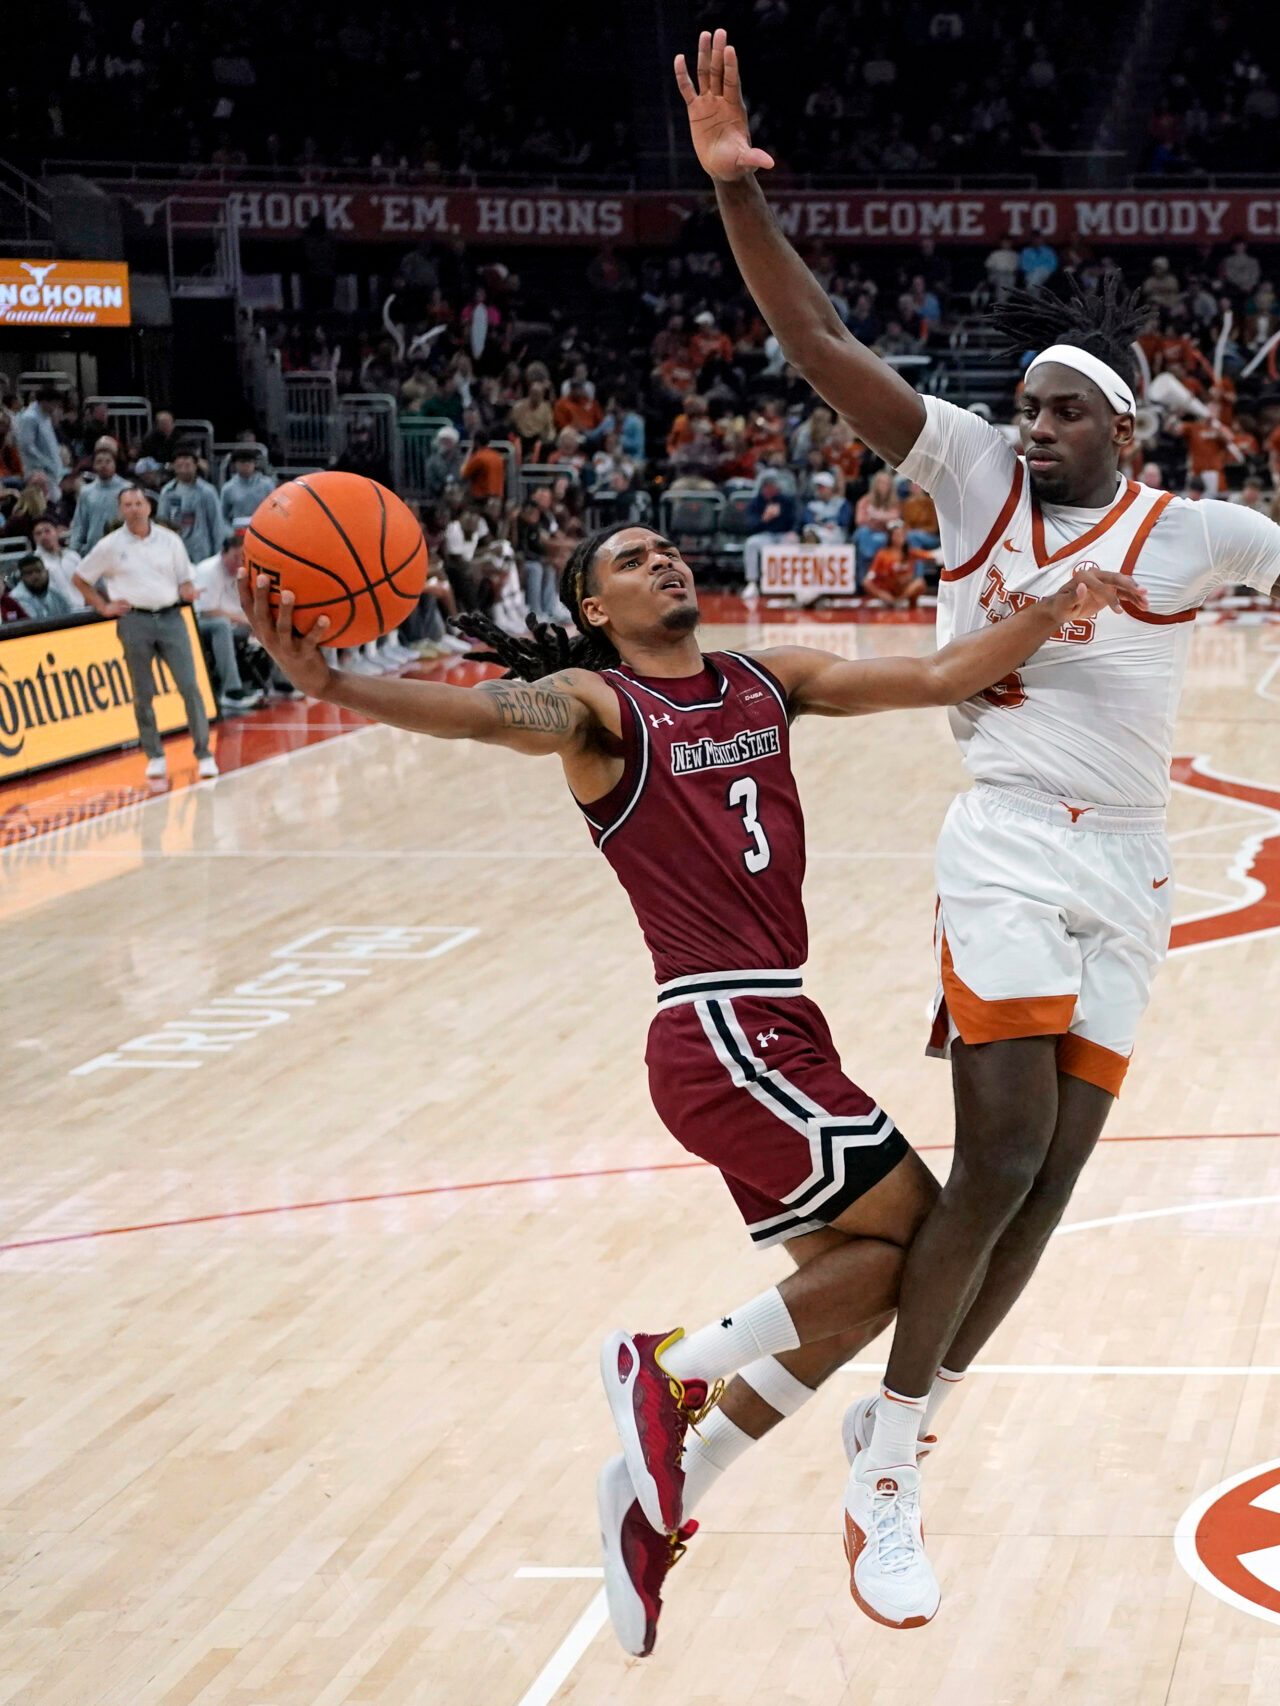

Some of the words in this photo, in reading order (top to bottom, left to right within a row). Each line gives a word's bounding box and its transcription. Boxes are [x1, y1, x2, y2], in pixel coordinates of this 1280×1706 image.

[228, 192, 355, 230] HOOK
[476, 199, 624, 236] HORNS
[769, 201, 985, 237] WELCOME
[1001, 202, 1058, 236] TO
[1074, 201, 1230, 236] MOODY
[767, 555, 849, 588] DEFENSE
[675, 744, 702, 771] NEW
[704, 741, 740, 765] MEXICO
[738, 730, 777, 760] STATE
[729, 776, 771, 874] 3
[69, 963, 372, 1077] TRUIST
